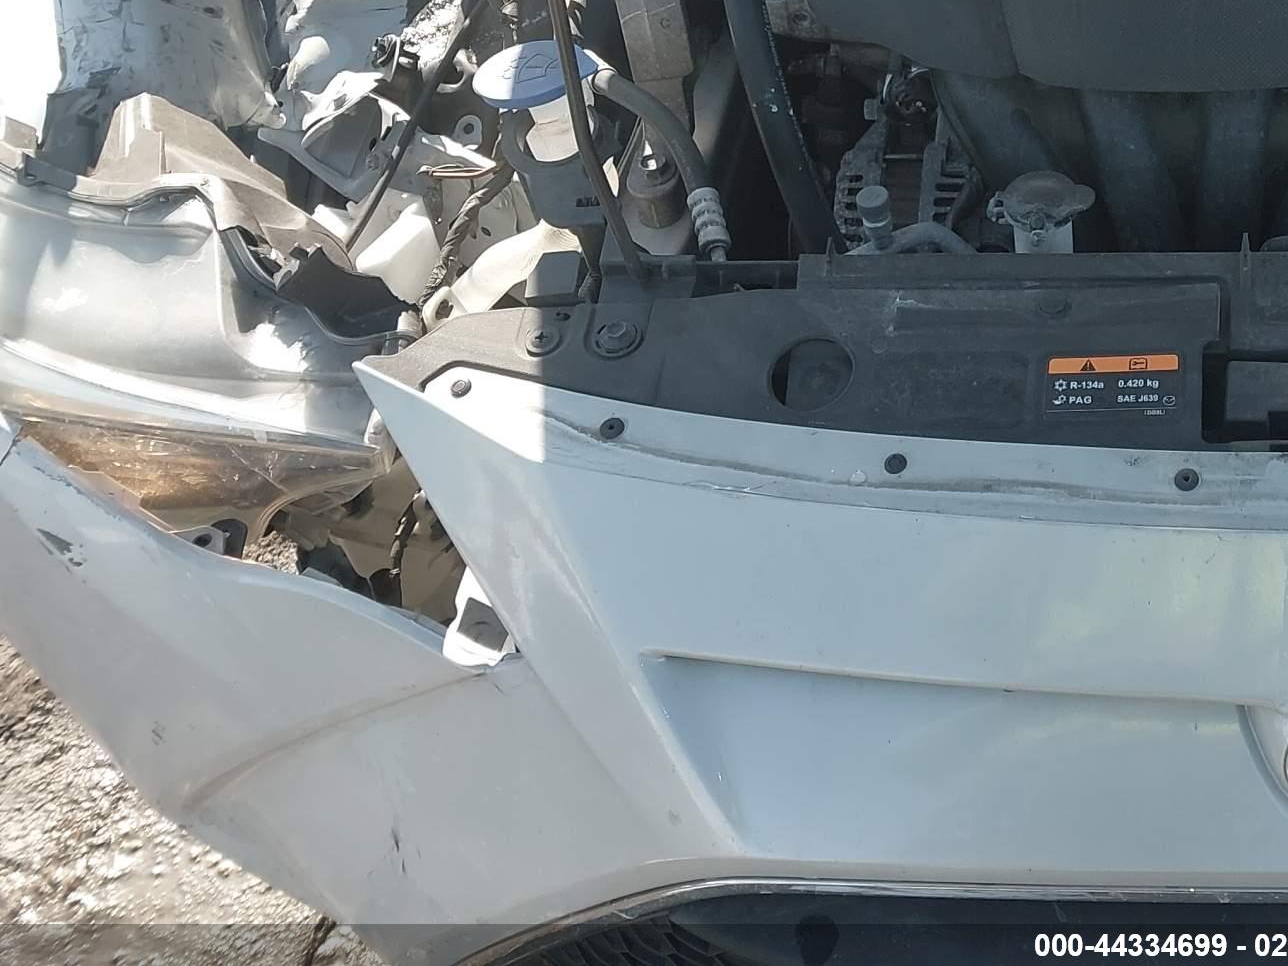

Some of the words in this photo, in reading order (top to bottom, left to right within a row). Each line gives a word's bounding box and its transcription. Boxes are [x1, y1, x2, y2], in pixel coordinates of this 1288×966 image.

[1069, 380, 1105, 390] R-134a
[1118, 379, 1145, 389] 0.420
[1146, 378, 1160, 389] kg
[1068, 395, 1093, 405] PAG
[1117, 395, 1137, 404] SAE
[1138, 394, 1160, 403] J639
